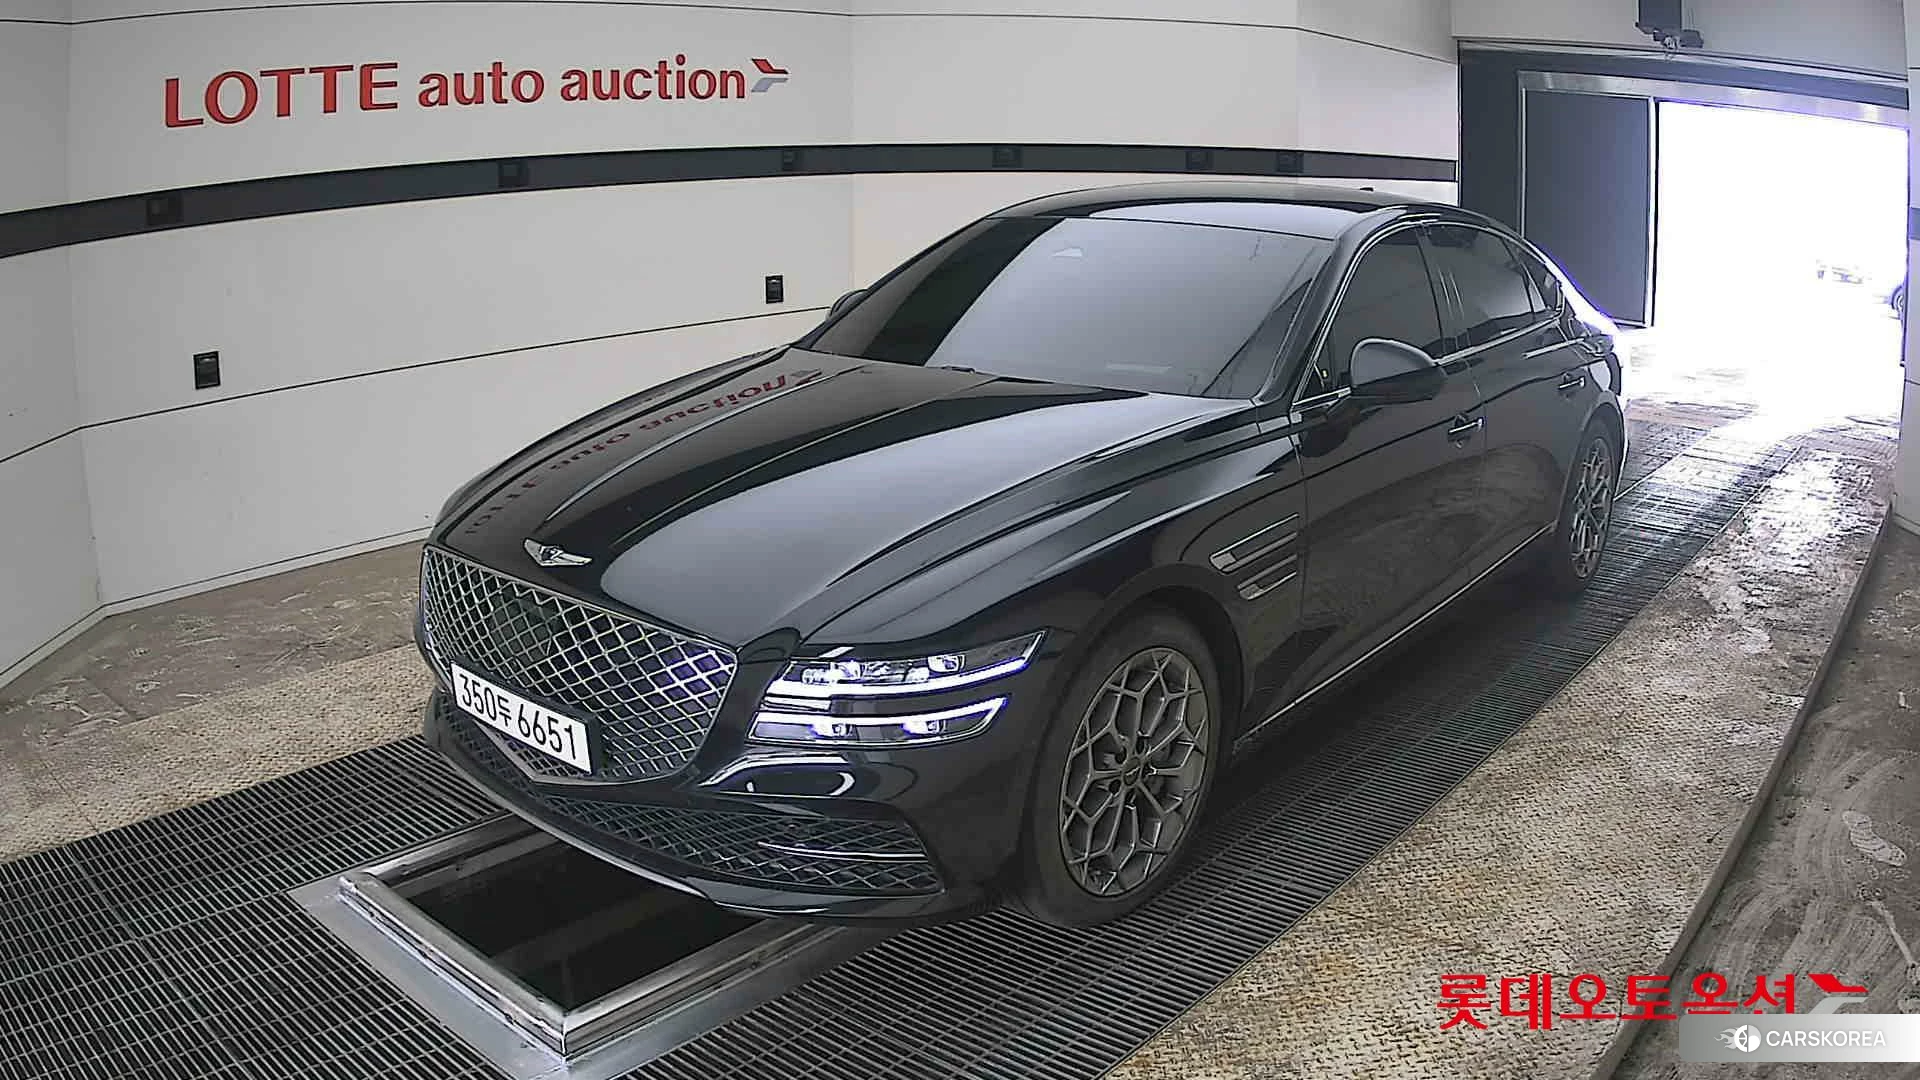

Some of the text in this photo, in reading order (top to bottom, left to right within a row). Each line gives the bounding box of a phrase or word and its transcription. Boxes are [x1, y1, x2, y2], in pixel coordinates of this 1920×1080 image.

[164, 53, 746, 129] LOTTE auto auction
[459, 673, 577, 760] 350두 6651
